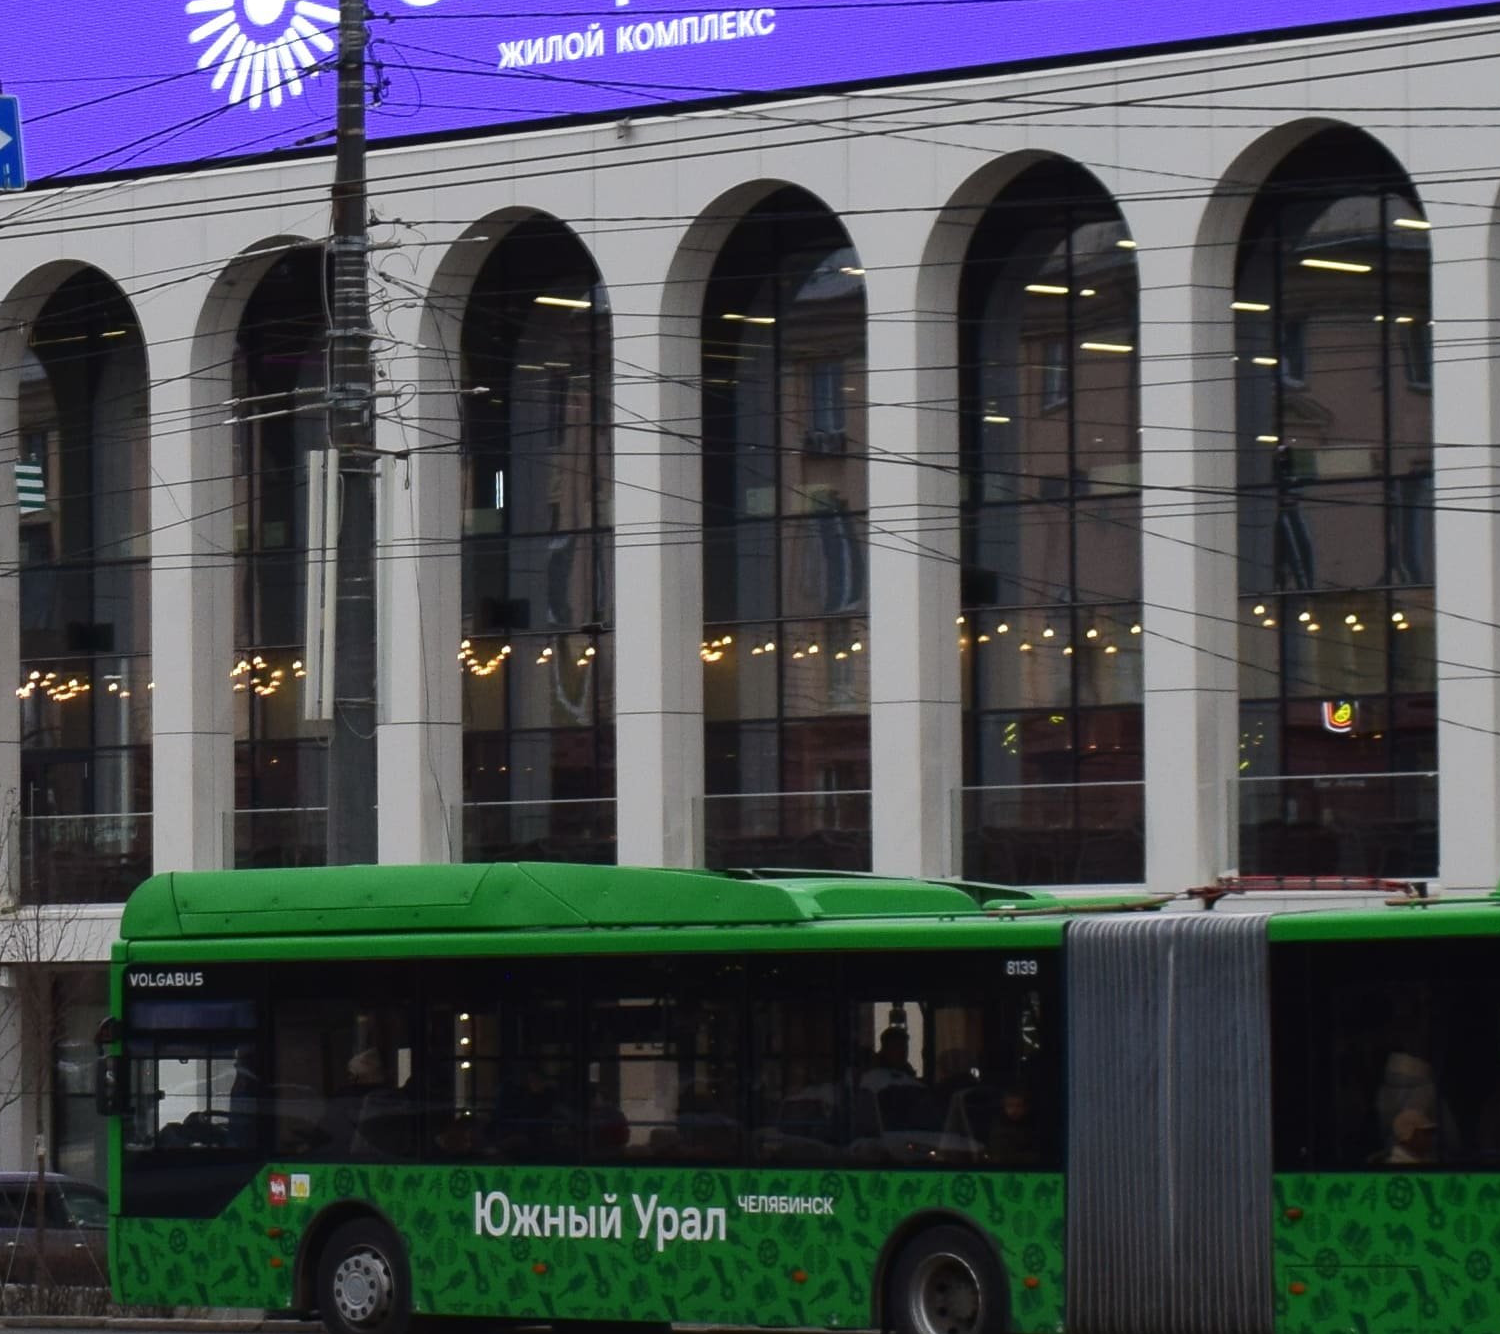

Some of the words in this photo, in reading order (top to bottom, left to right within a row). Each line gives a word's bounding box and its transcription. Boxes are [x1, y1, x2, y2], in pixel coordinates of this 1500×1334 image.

[1006, 959, 1038, 976] 8139
[129, 971, 204, 988] VOLGABUS
[737, 1194, 835, 1216] ЧЕЛЯБИНСК
[473, 1190, 623, 1239] Южный
[637, 1191, 727, 1254] Урал
